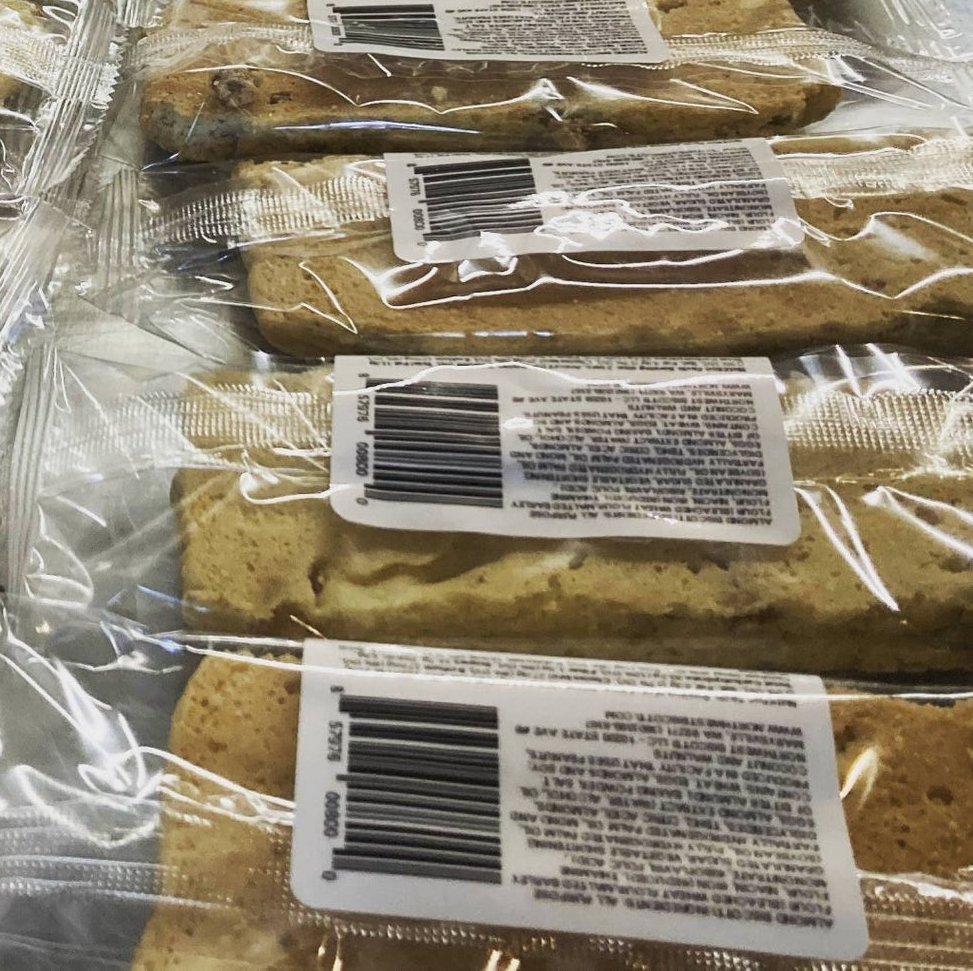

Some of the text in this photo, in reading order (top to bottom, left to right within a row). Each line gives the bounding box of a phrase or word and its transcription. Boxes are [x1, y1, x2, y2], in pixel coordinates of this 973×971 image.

[327, 721, 343, 762] 57976
[323, 791, 340, 838] 00800
[321, 870, 337, 881] 0
